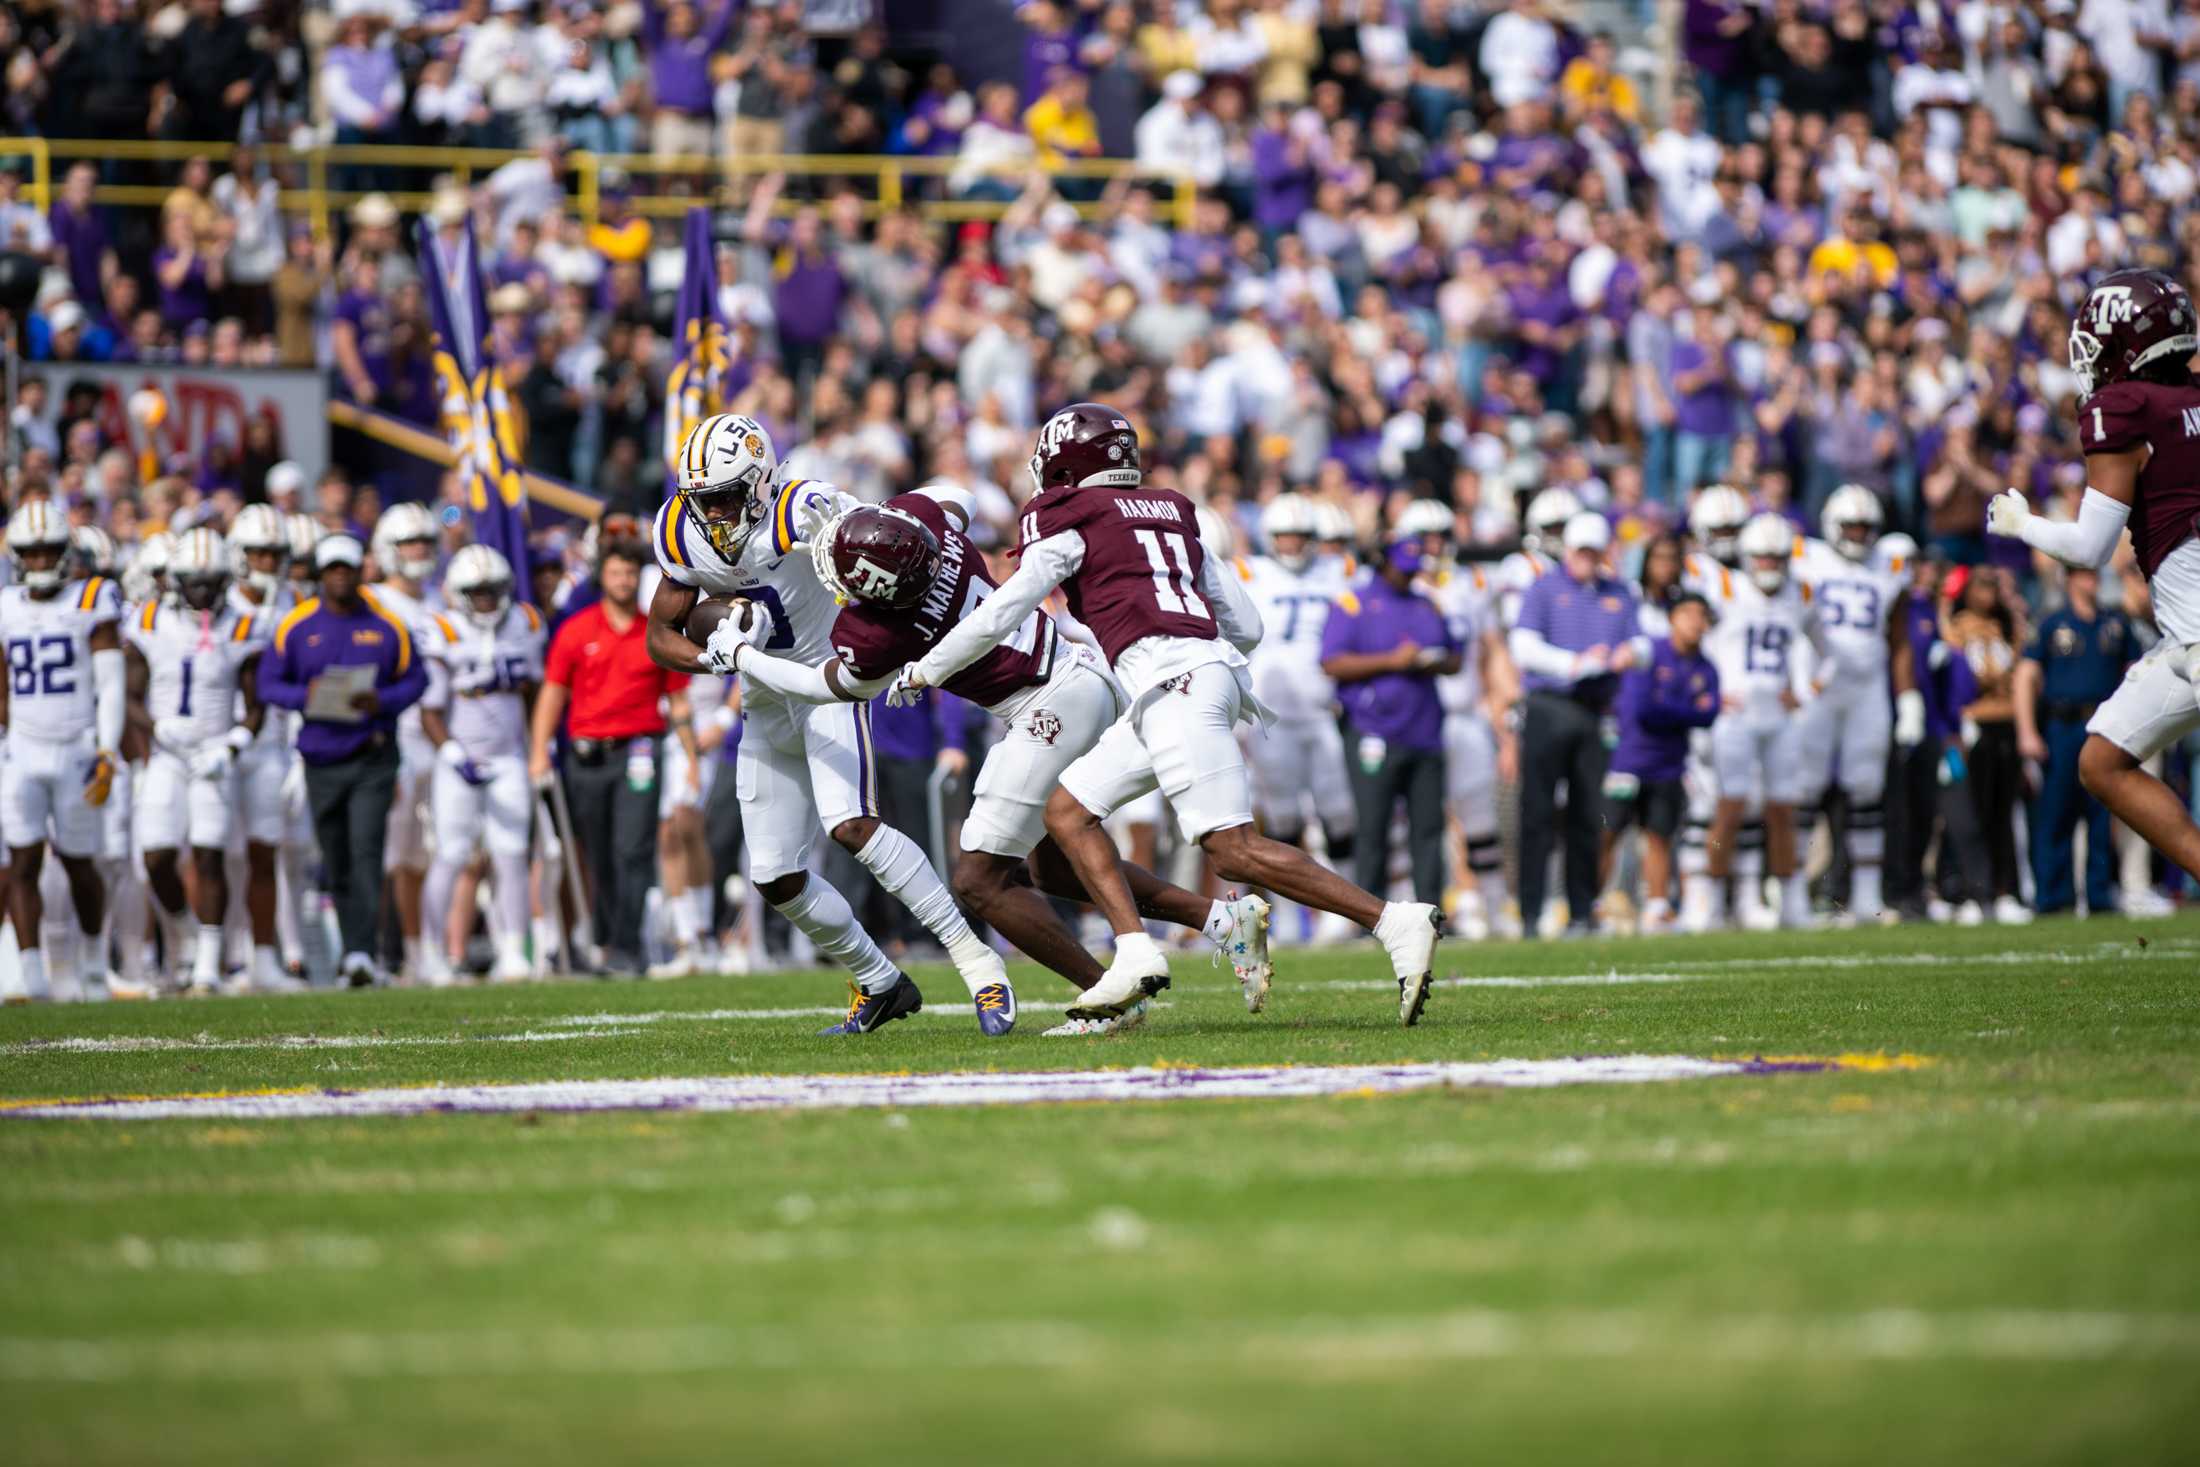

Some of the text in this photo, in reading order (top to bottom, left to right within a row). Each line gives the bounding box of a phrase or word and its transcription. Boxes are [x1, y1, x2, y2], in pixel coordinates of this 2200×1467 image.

[717, 417, 760, 457] LSU
[2092, 407, 2107, 441] 1
[1021, 511, 1042, 545] 11
[1113, 498, 1183, 522] HARMON
[913, 530, 966, 642] J. MATHEWS
[1134, 529, 1211, 620] 11
[1816, 579, 1878, 629] 53
[8, 636, 76, 694] 82
[837, 645, 862, 673] 2
[1746, 622, 1789, 672] 19
[178, 656, 193, 716] 1
